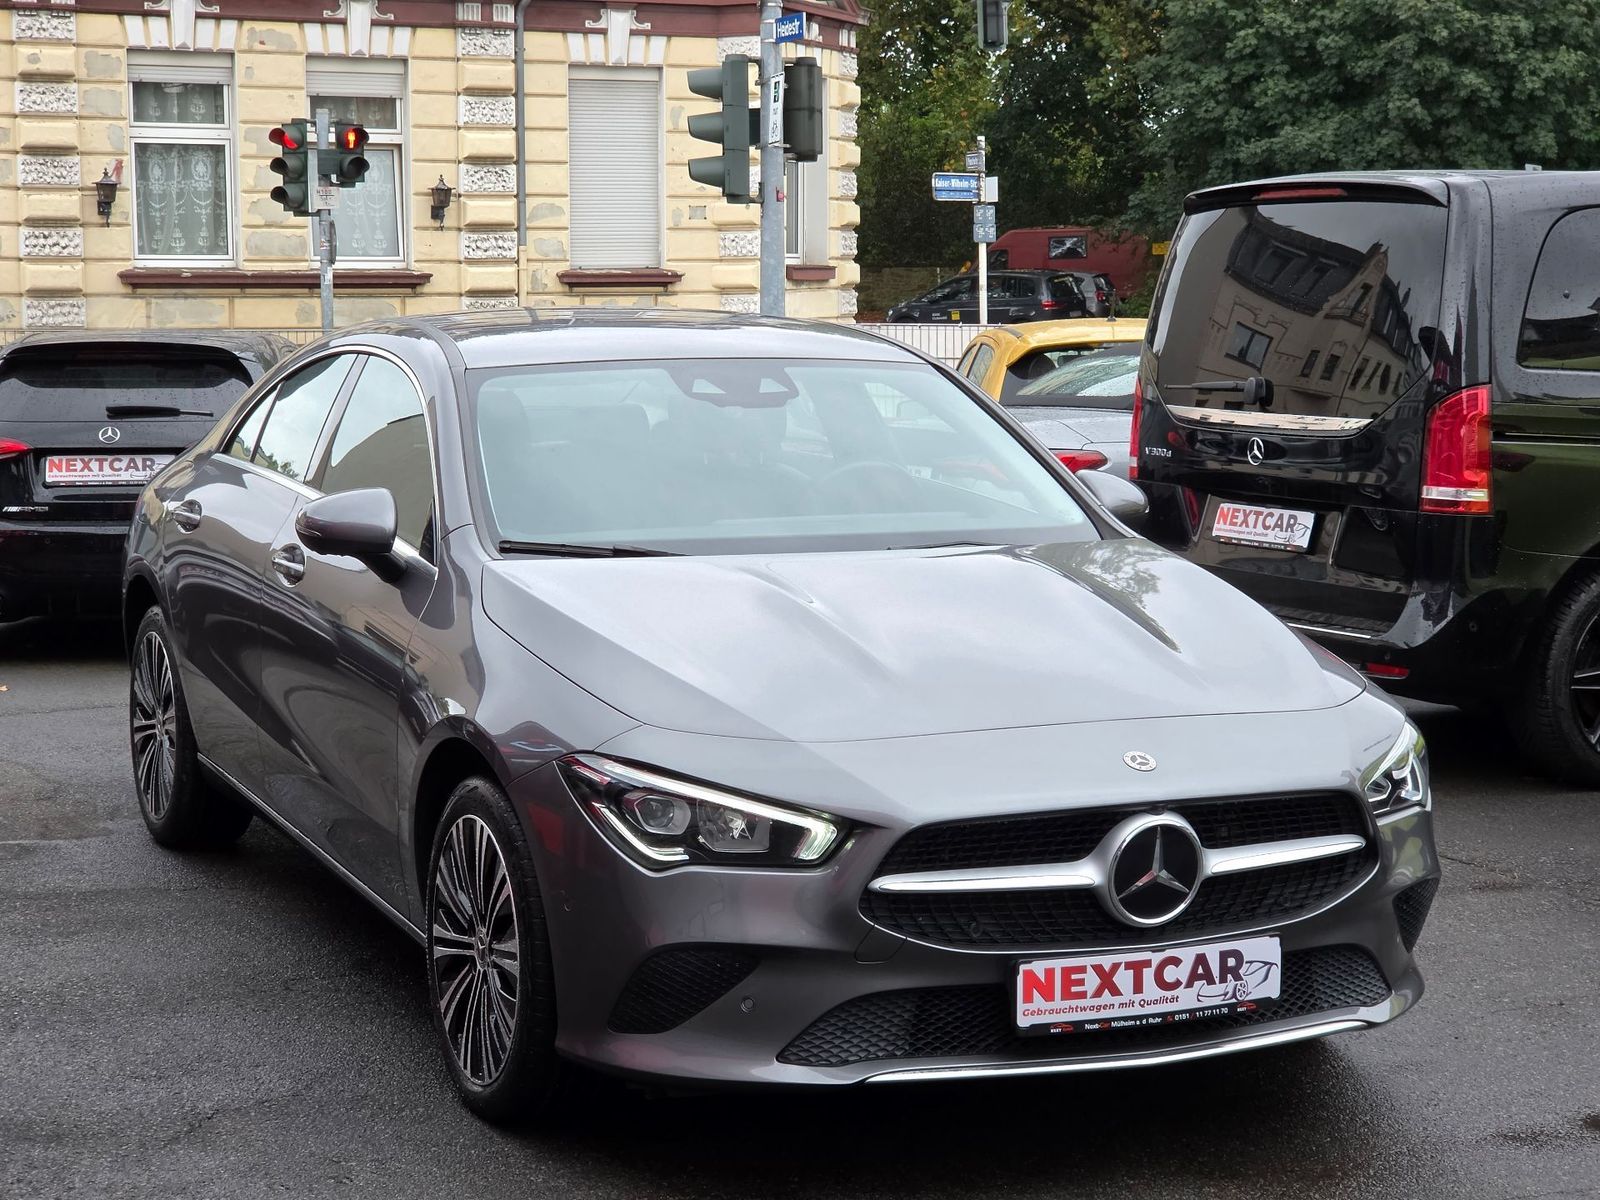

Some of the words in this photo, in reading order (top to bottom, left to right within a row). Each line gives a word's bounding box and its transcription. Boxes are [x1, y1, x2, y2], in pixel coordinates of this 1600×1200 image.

[48, 457, 156, 473] NEXTCAR
[1216, 506, 1298, 533] NEXTCAR
[1022, 948, 1244, 1005] NEXTCAR
[1022, 1002, 1115, 1018] Gebrauchtwagen
[1118, 999, 1136, 1010] mit
[1138, 995, 1179, 1008] Qualität
[1174, 1013, 1190, 1021] 0151
